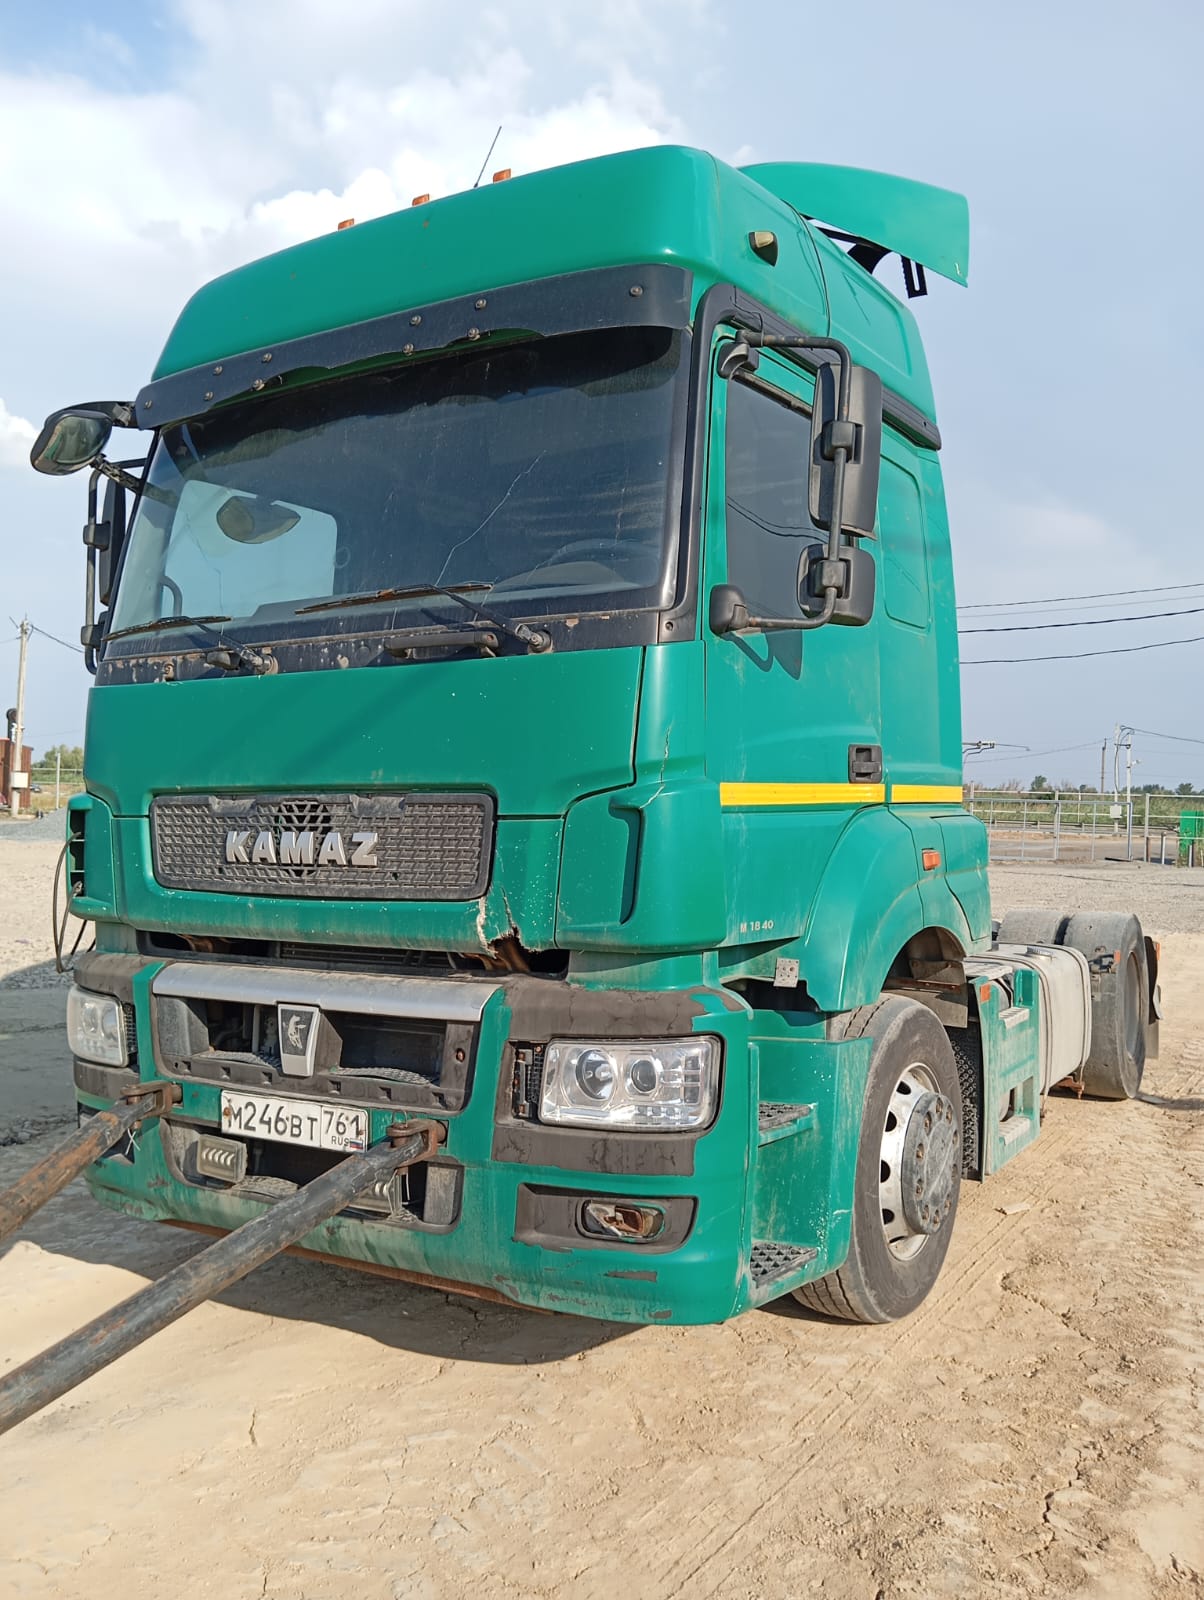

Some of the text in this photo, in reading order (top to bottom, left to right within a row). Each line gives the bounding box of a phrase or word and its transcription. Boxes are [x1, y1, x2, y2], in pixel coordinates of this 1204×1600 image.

[225, 830, 379, 868] KAMAZ
[323, 1110, 361, 1137] 761
[331, 1135, 350, 1147] RUS
